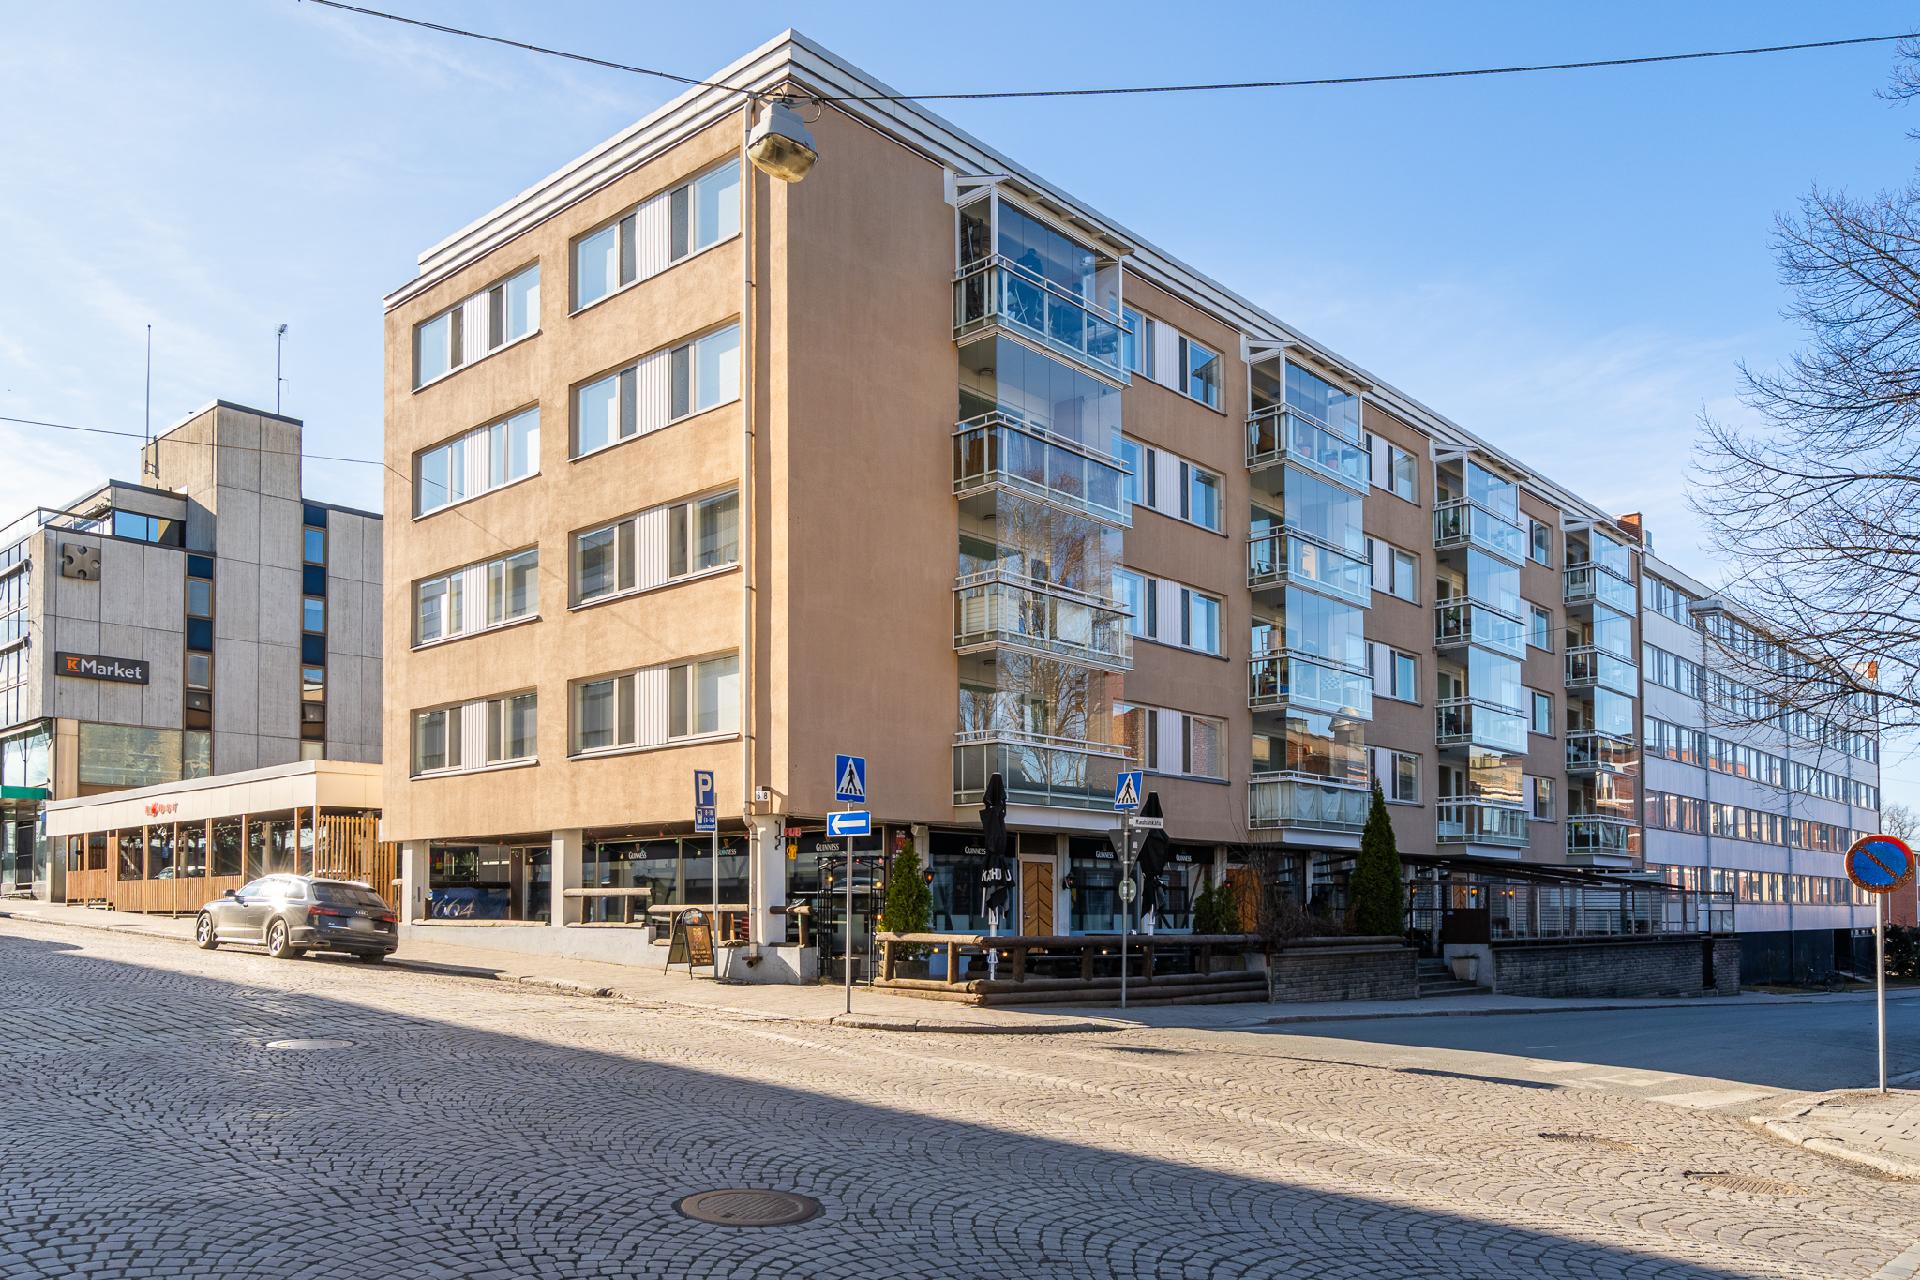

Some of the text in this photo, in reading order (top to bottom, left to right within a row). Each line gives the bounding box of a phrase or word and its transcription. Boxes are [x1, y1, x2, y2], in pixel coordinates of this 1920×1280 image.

[81, 658, 142, 679] Market
[697, 773, 712, 805] P
[816, 843, 840, 852] GUINNESS
[1095, 851, 1114, 859] GUINNESS
